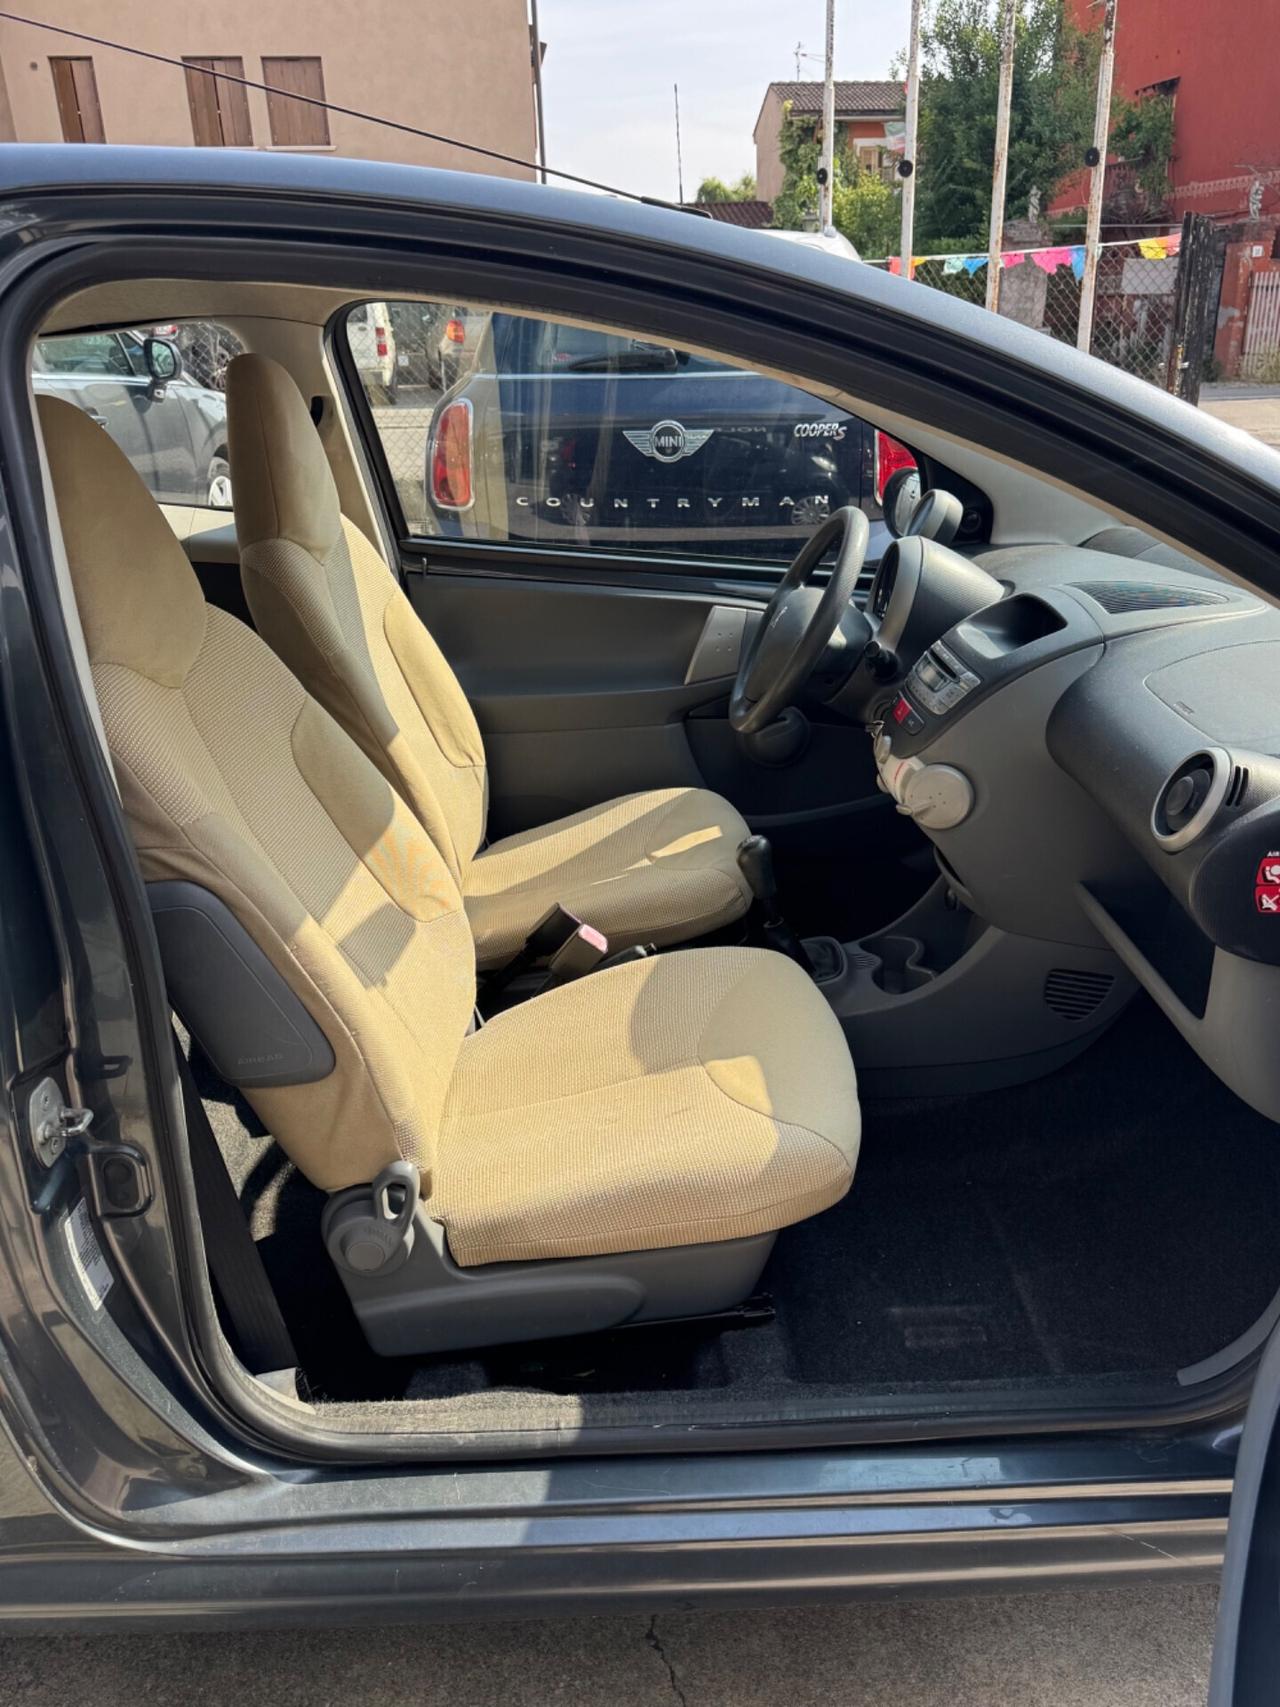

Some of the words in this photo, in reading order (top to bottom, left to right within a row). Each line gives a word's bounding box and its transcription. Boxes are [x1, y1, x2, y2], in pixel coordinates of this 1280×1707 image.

[793, 422, 839, 437] COOPER
[833, 426, 847, 440] S
[655, 435, 682, 448] MINI
[516, 495, 829, 508] COUNTRYMAN
